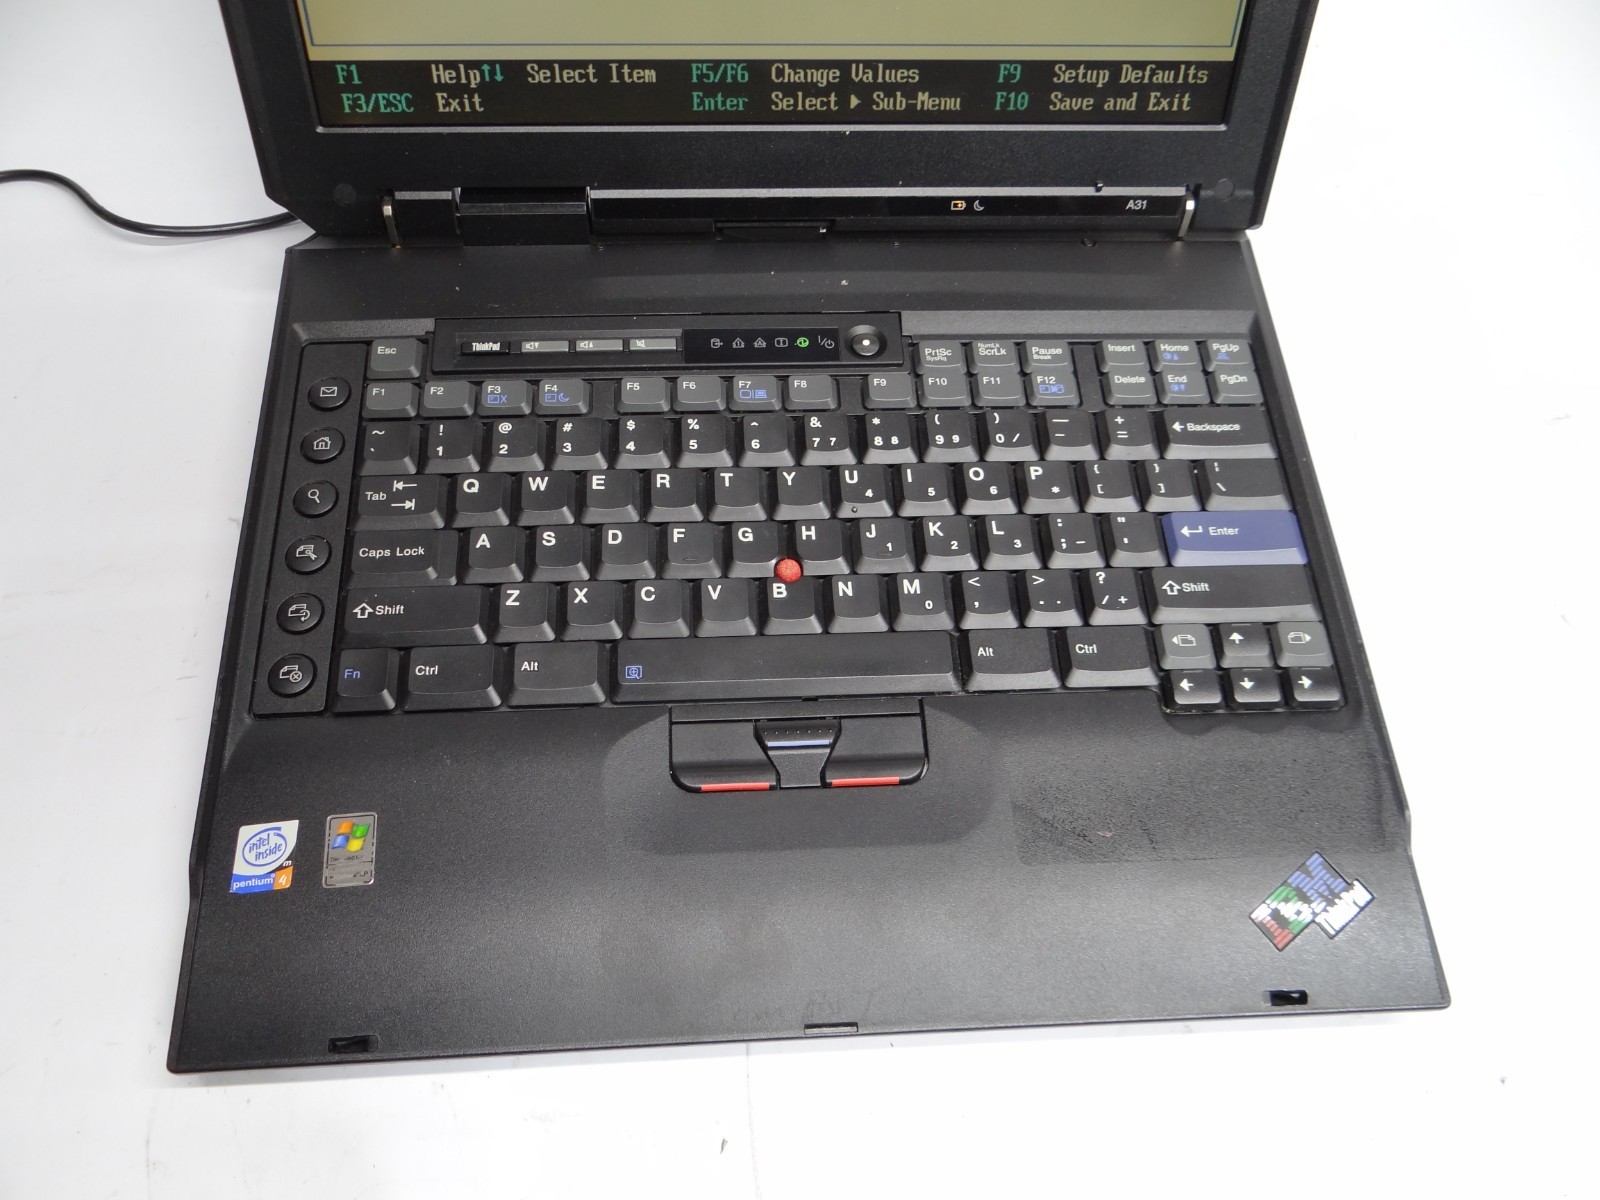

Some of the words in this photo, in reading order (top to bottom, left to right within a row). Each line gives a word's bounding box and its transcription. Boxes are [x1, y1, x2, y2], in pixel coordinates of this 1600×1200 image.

[336, 65, 362, 84] F1
[432, 64, 480, 88] Help
[527, 64, 597, 84] Select
[610, 65, 656, 83] Item
[691, 63, 749, 83] F5/F6
[771, 64, 840, 85] Change
[851, 65, 919, 83] Values
[998, 64, 1021, 83] F9
[1053, 64, 1109, 86] Setup
[1120, 64, 1208, 83] Defaults
[342, 93, 414, 113] F3/ESC
[437, 93, 484, 112] Exit
[692, 93, 748, 111] Enter
[771, 93, 838, 111] Select
[872, 92, 961, 111] Sub-Menu
[995, 93, 1028, 111] F10
[1049, 93, 1094, 111] Save
[1104, 93, 1136, 111] and
[1147, 93, 1191, 111] Exit
[1126, 200, 1147, 209] A31
[472, 342, 500, 351] ThinkPad
[979, 347, 1007, 356] ScrLk
[1032, 347, 1062, 355] Pause
[1212, 343, 1240, 352] PgUp
[925, 348, 952, 356] PrtSc
[1037, 376, 1056, 384] F12
[1168, 375, 1187, 383] End
[1220, 375, 1247, 384] PgDn
[488, 385, 501, 394] F3
[545, 384, 558, 393] F4
[738, 381, 751, 389] F7
[688, 419, 699, 429] %
[810, 417, 821, 427] &
[1115, 416, 1124, 424] +
[499, 423, 512, 433] @
[563, 423, 572, 432] #
[627, 420, 635, 431] $
[1187, 423, 1240, 432] Backspace
[813, 438, 820, 447] 7
[874, 436, 883, 446] 8
[891, 436, 898, 444] 8
[936, 435, 944, 444] 9
[952, 435, 959, 443] 9
[996, 434, 1004, 443] 0
[1013, 434, 1019, 442] /
[499, 444, 508, 454] 2
[563, 443, 571, 452] 3
[626, 442, 635, 451] 4
[690, 440, 697, 449] 5
[752, 439, 760, 449] 6
[845, 470, 858, 483] U
[969, 467, 984, 481] O
[1030, 467, 1042, 479] P
[592, 476, 605, 489] E
[657, 474, 670, 488] R
[720, 473, 733, 486] T
[783, 472, 795, 485] Y
[463, 479, 479, 492] Q
[529, 477, 548, 491] W
[1097, 484, 1104, 493] [
[1158, 484, 1165, 493] ]
[865, 489, 873, 497] 4
[928, 488, 935, 496] 5
[990, 486, 997, 494] 6
[366, 492, 386, 500] Tab
[866, 524, 876, 538] J
[929, 522, 943, 536] K
[992, 521, 1004, 534] L
[1209, 527, 1239, 535] Enter
[608, 530, 622, 544] D
[674, 529, 685, 542] F
[738, 528, 753, 541] G
[802, 526, 815, 540] H
[476, 534, 490, 548] A
[543, 532, 555, 546] S
[1014, 540, 1021, 548] 3
[951, 541, 958, 549] 2
[359, 548, 390, 558] Caps
[397, 547, 424, 556] Lock
[968, 577, 980, 586] <
[1032, 576, 1044, 584] >
[1096, 572, 1105, 583] ?
[773, 583, 787, 598] B
[838, 582, 852, 596] N
[903, 579, 920, 594] M
[1182, 582, 1210, 592] Shift
[574, 588, 588, 603] X
[641, 587, 655, 601] C
[708, 585, 721, 599] V
[506, 590, 520, 605] Z
[376, 605, 404, 615] Shift
[925, 601, 933, 609] 0
[978, 647, 993, 656] Alt
[1076, 644, 1097, 653] Ctrl
[416, 666, 438, 675] Ctrl
[521, 662, 538, 670] Alt
[345, 669, 360, 678] Fn
[249, 833, 270, 854] intel
[255, 843, 283, 862] inside
[278, 874, 287, 886] 4
